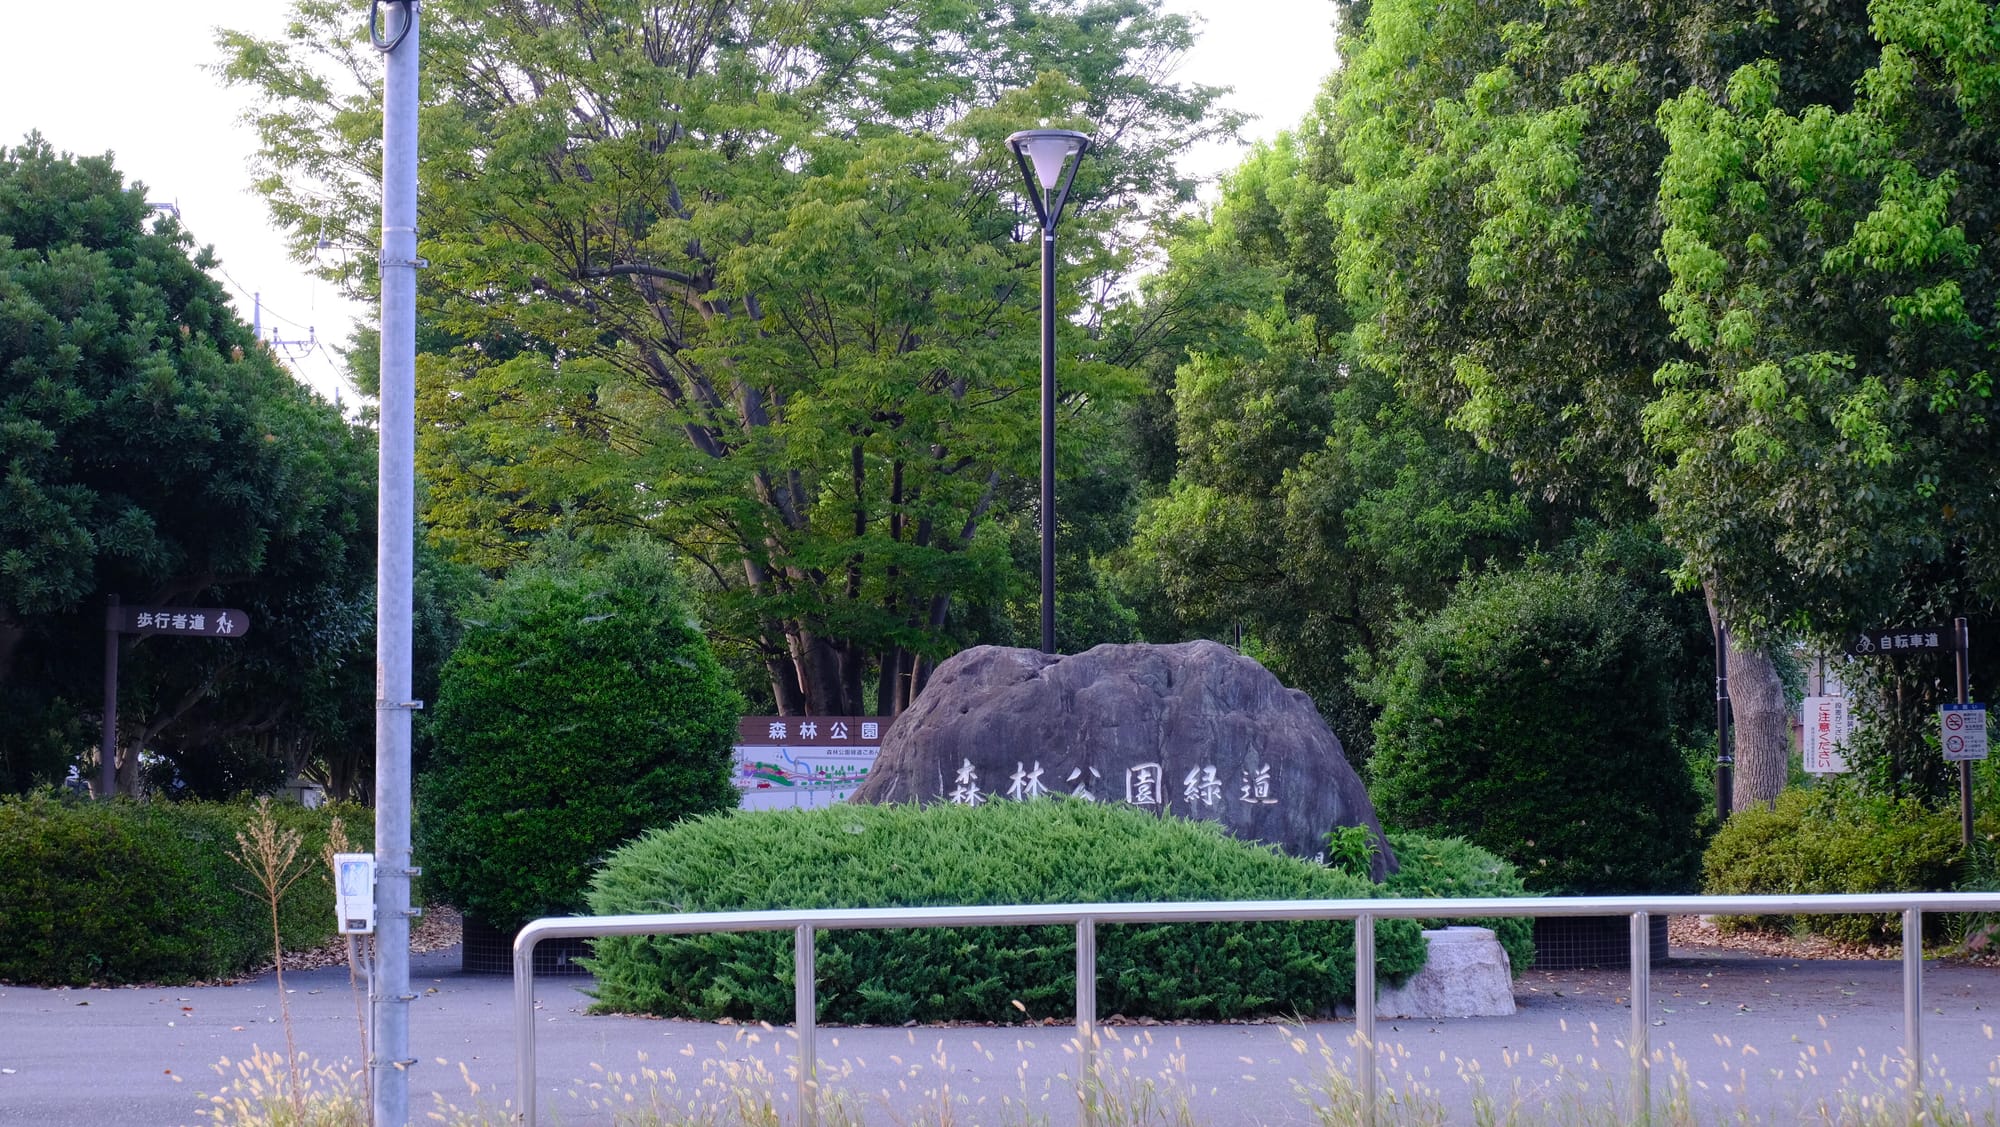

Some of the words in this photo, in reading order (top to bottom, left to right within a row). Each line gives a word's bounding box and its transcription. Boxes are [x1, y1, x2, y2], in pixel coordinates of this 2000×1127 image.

[137, 612, 205, 630] 歩行者道
[1880, 632, 1939, 650] 自転車道
[769, 721, 878, 740] 森林公園
[1818, 702, 1831, 768] ご注意ください
[949, 757, 1279, 806] 森林公園緑道
